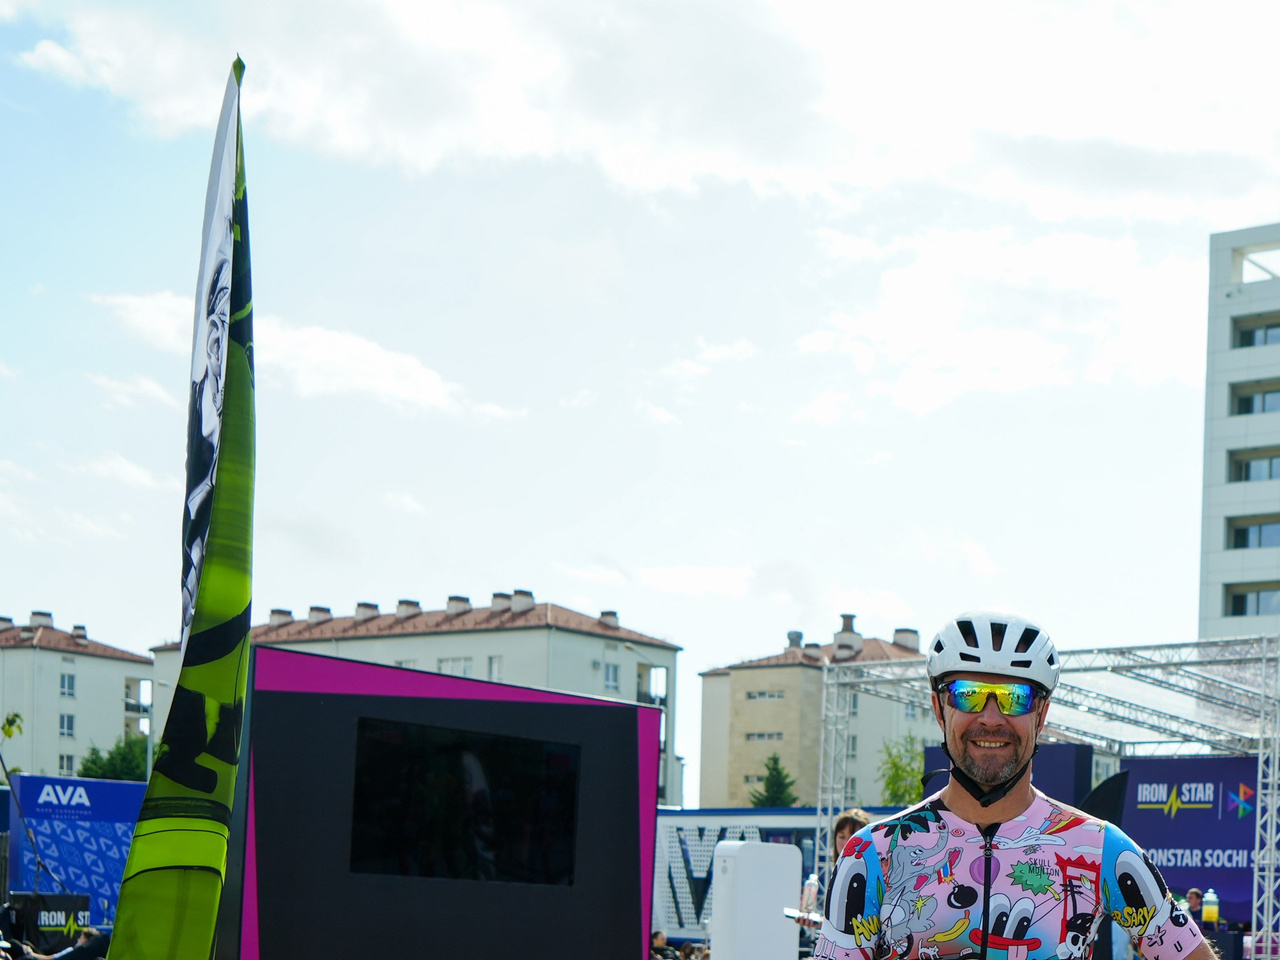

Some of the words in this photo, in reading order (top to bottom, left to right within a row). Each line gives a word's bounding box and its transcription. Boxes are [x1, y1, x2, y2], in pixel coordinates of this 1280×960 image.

[37, 784, 91, 806] AVA
[1137, 783, 1167, 802] IRON
[1180, 783, 1214, 802] STAR
[1028, 857, 1052, 867] SKULL
[1146, 849, 1201, 868] ONSTAR
[1204, 849, 1247, 868] SOCHI
[1028, 866, 1060, 877] MONTON
[77, 911, 90, 924] ST
